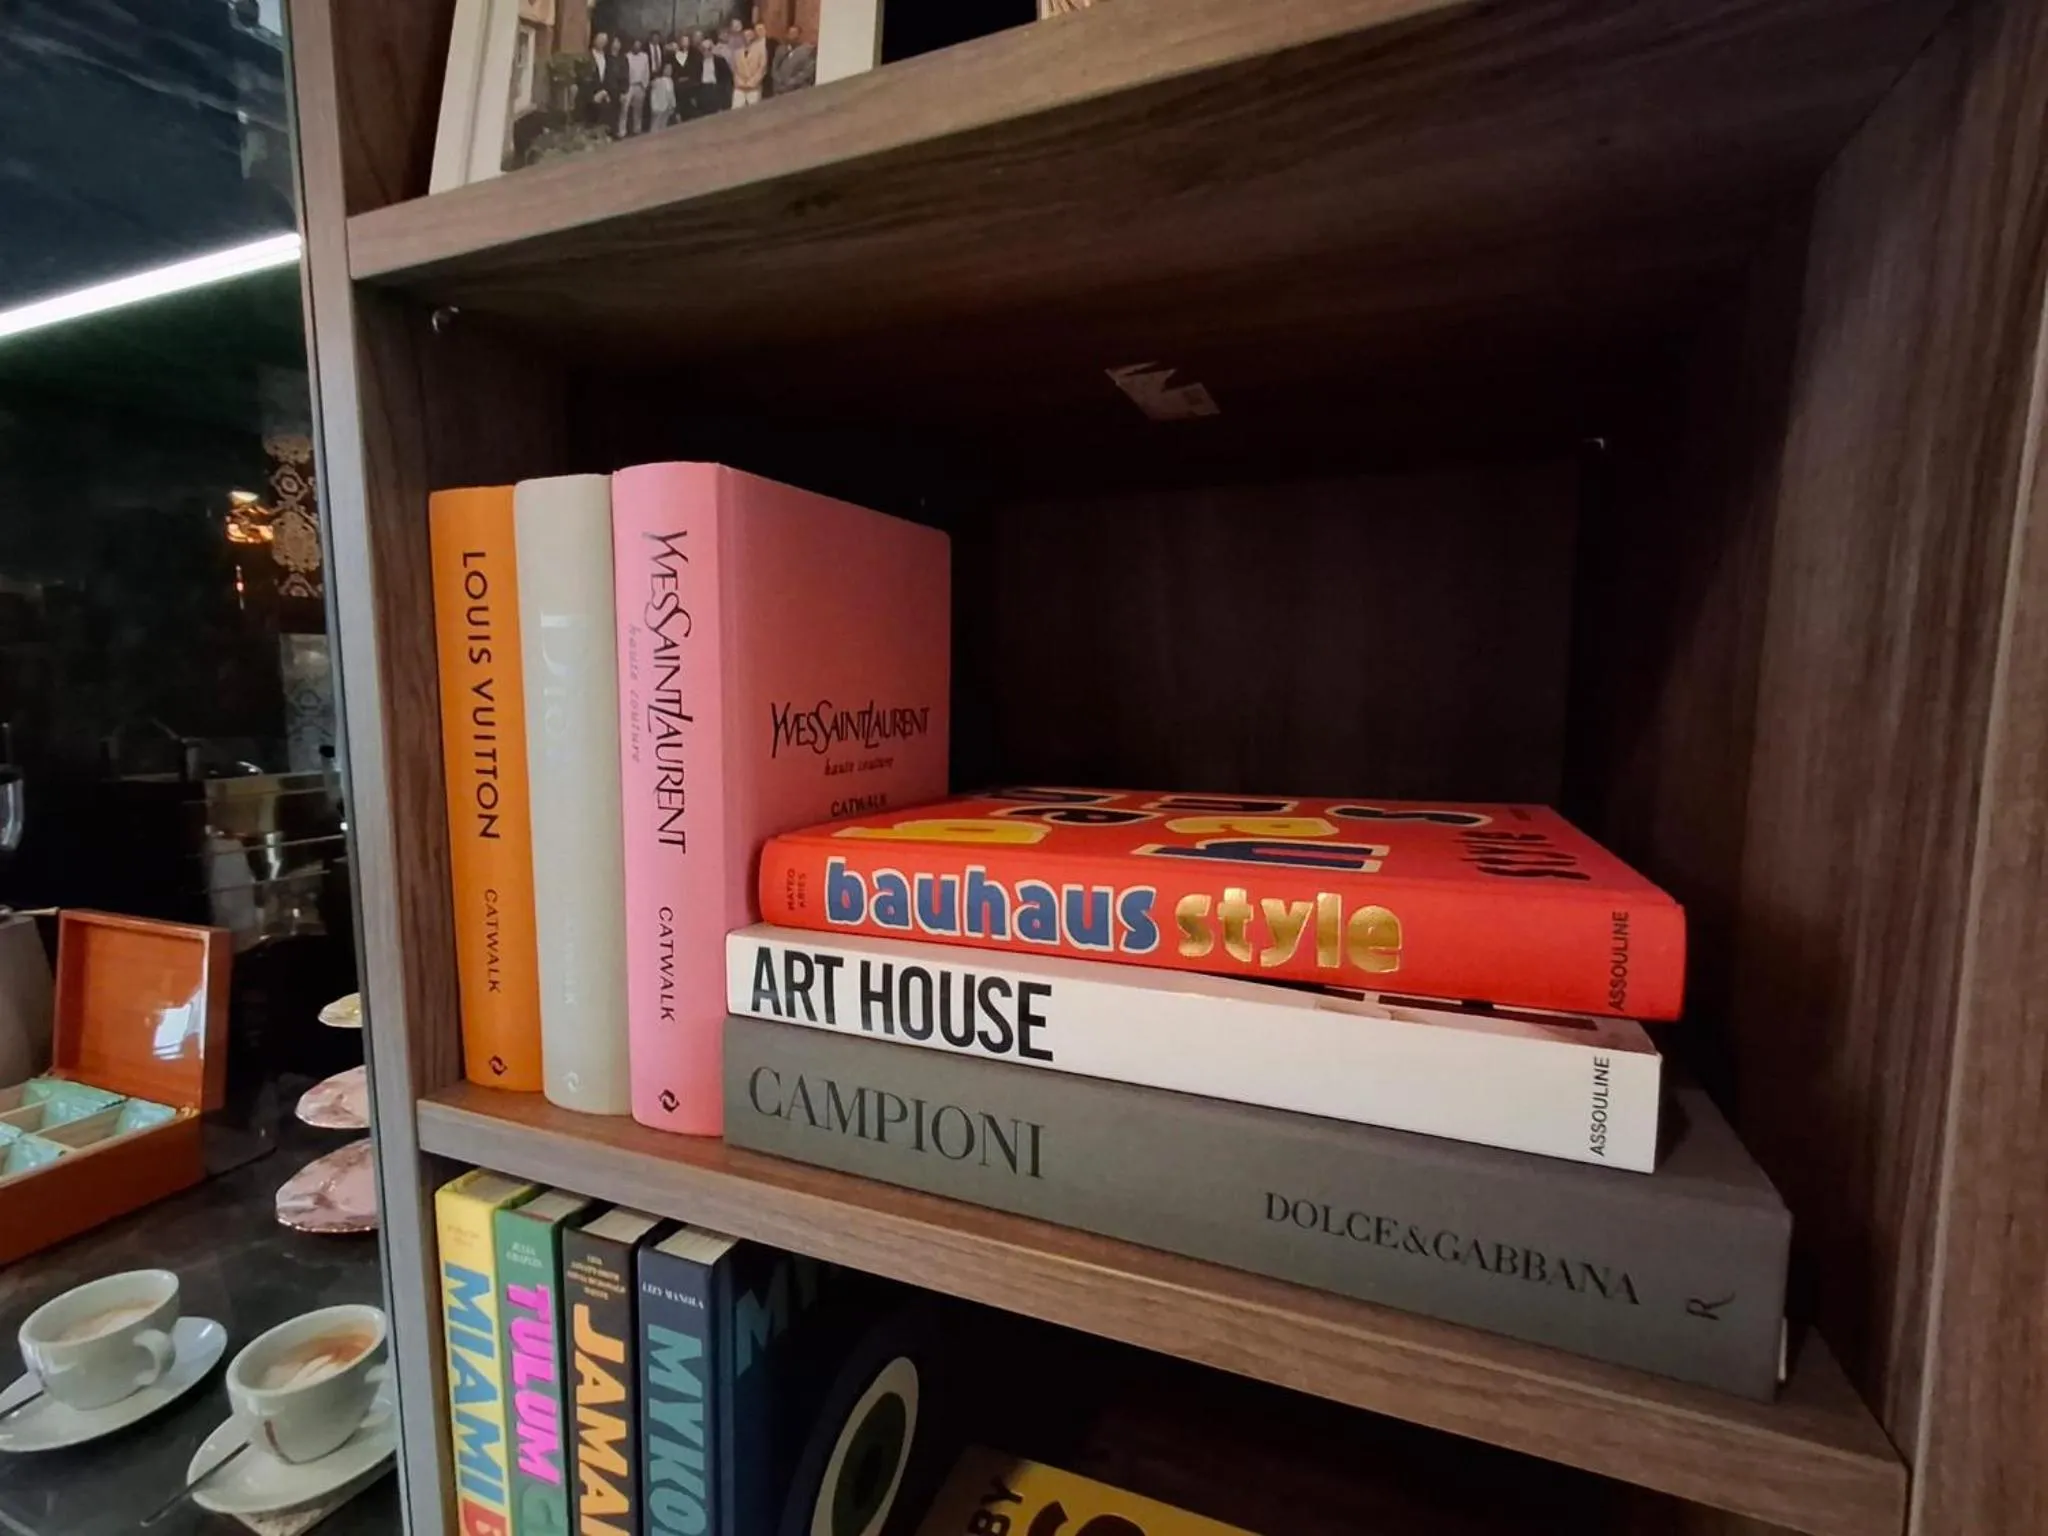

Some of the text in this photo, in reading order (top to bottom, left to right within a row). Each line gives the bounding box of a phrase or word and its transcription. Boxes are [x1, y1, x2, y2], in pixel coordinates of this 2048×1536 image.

[462, 552, 501, 840] LOUIS VUITTON
[630, 688, 643, 765] couture
[830, 793, 888, 819] CATWALK
[484, 887, 502, 994] CATWALK
[785, 868, 796, 911] MATEO
[825, 855, 1403, 973] bauhaus style
[658, 906, 676, 1023] CATWALK
[751, 946, 1054, 1062] ART HOUSE
[1608, 911, 1630, 1011] ASSOULINE
[748, 1065, 1045, 1179] CAMPIONI
[1590, 1056, 1611, 1157] ASSOULINE
[1264, 1192, 1641, 1306] DOLCE&GABBANA
[444, 1261, 507, 1506] MIAMI
[506, 1283, 562, 1486] TULUM
[646, 1322, 708, 1536] MYKO
